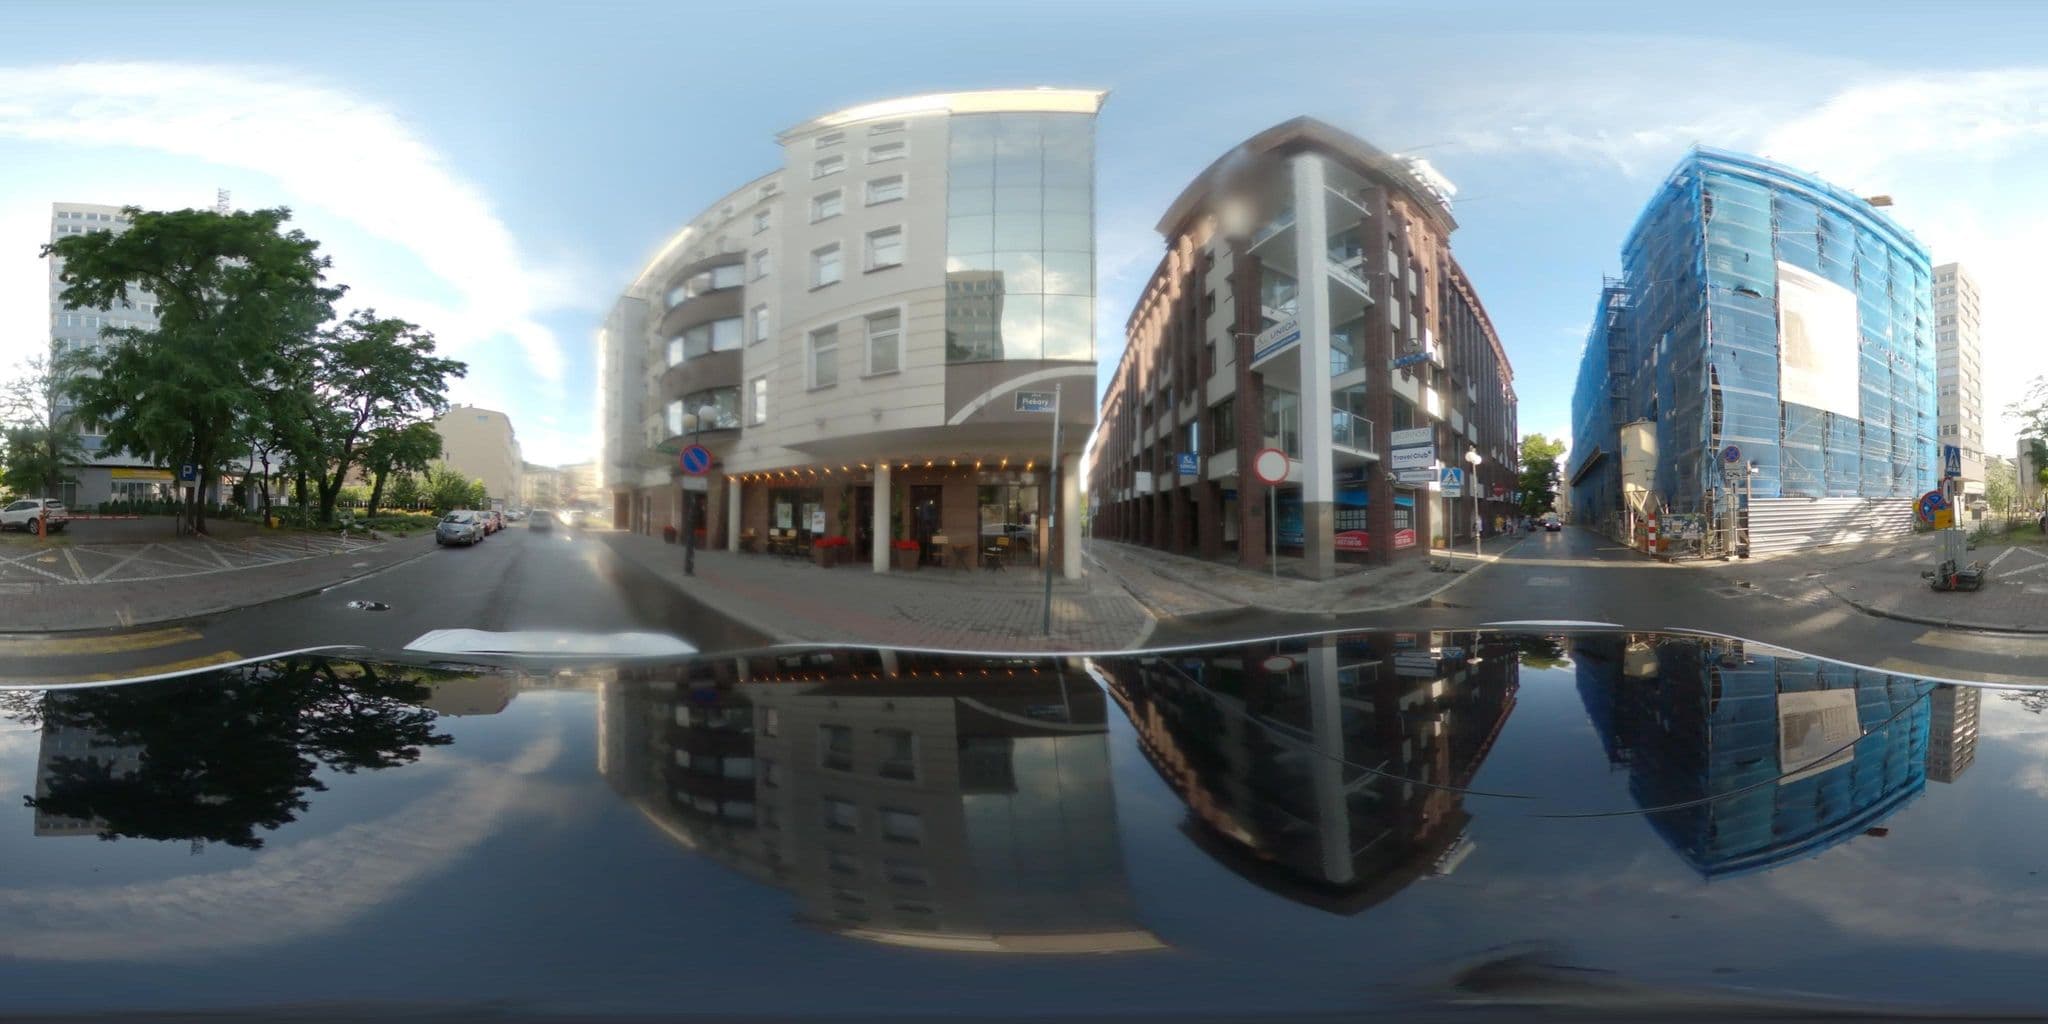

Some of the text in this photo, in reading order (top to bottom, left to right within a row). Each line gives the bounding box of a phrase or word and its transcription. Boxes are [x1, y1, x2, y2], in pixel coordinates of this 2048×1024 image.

[1022, 398, 1049, 407] Piekary
[1412, 450, 1429, 459] Club
[182, 465, 193, 478] P
